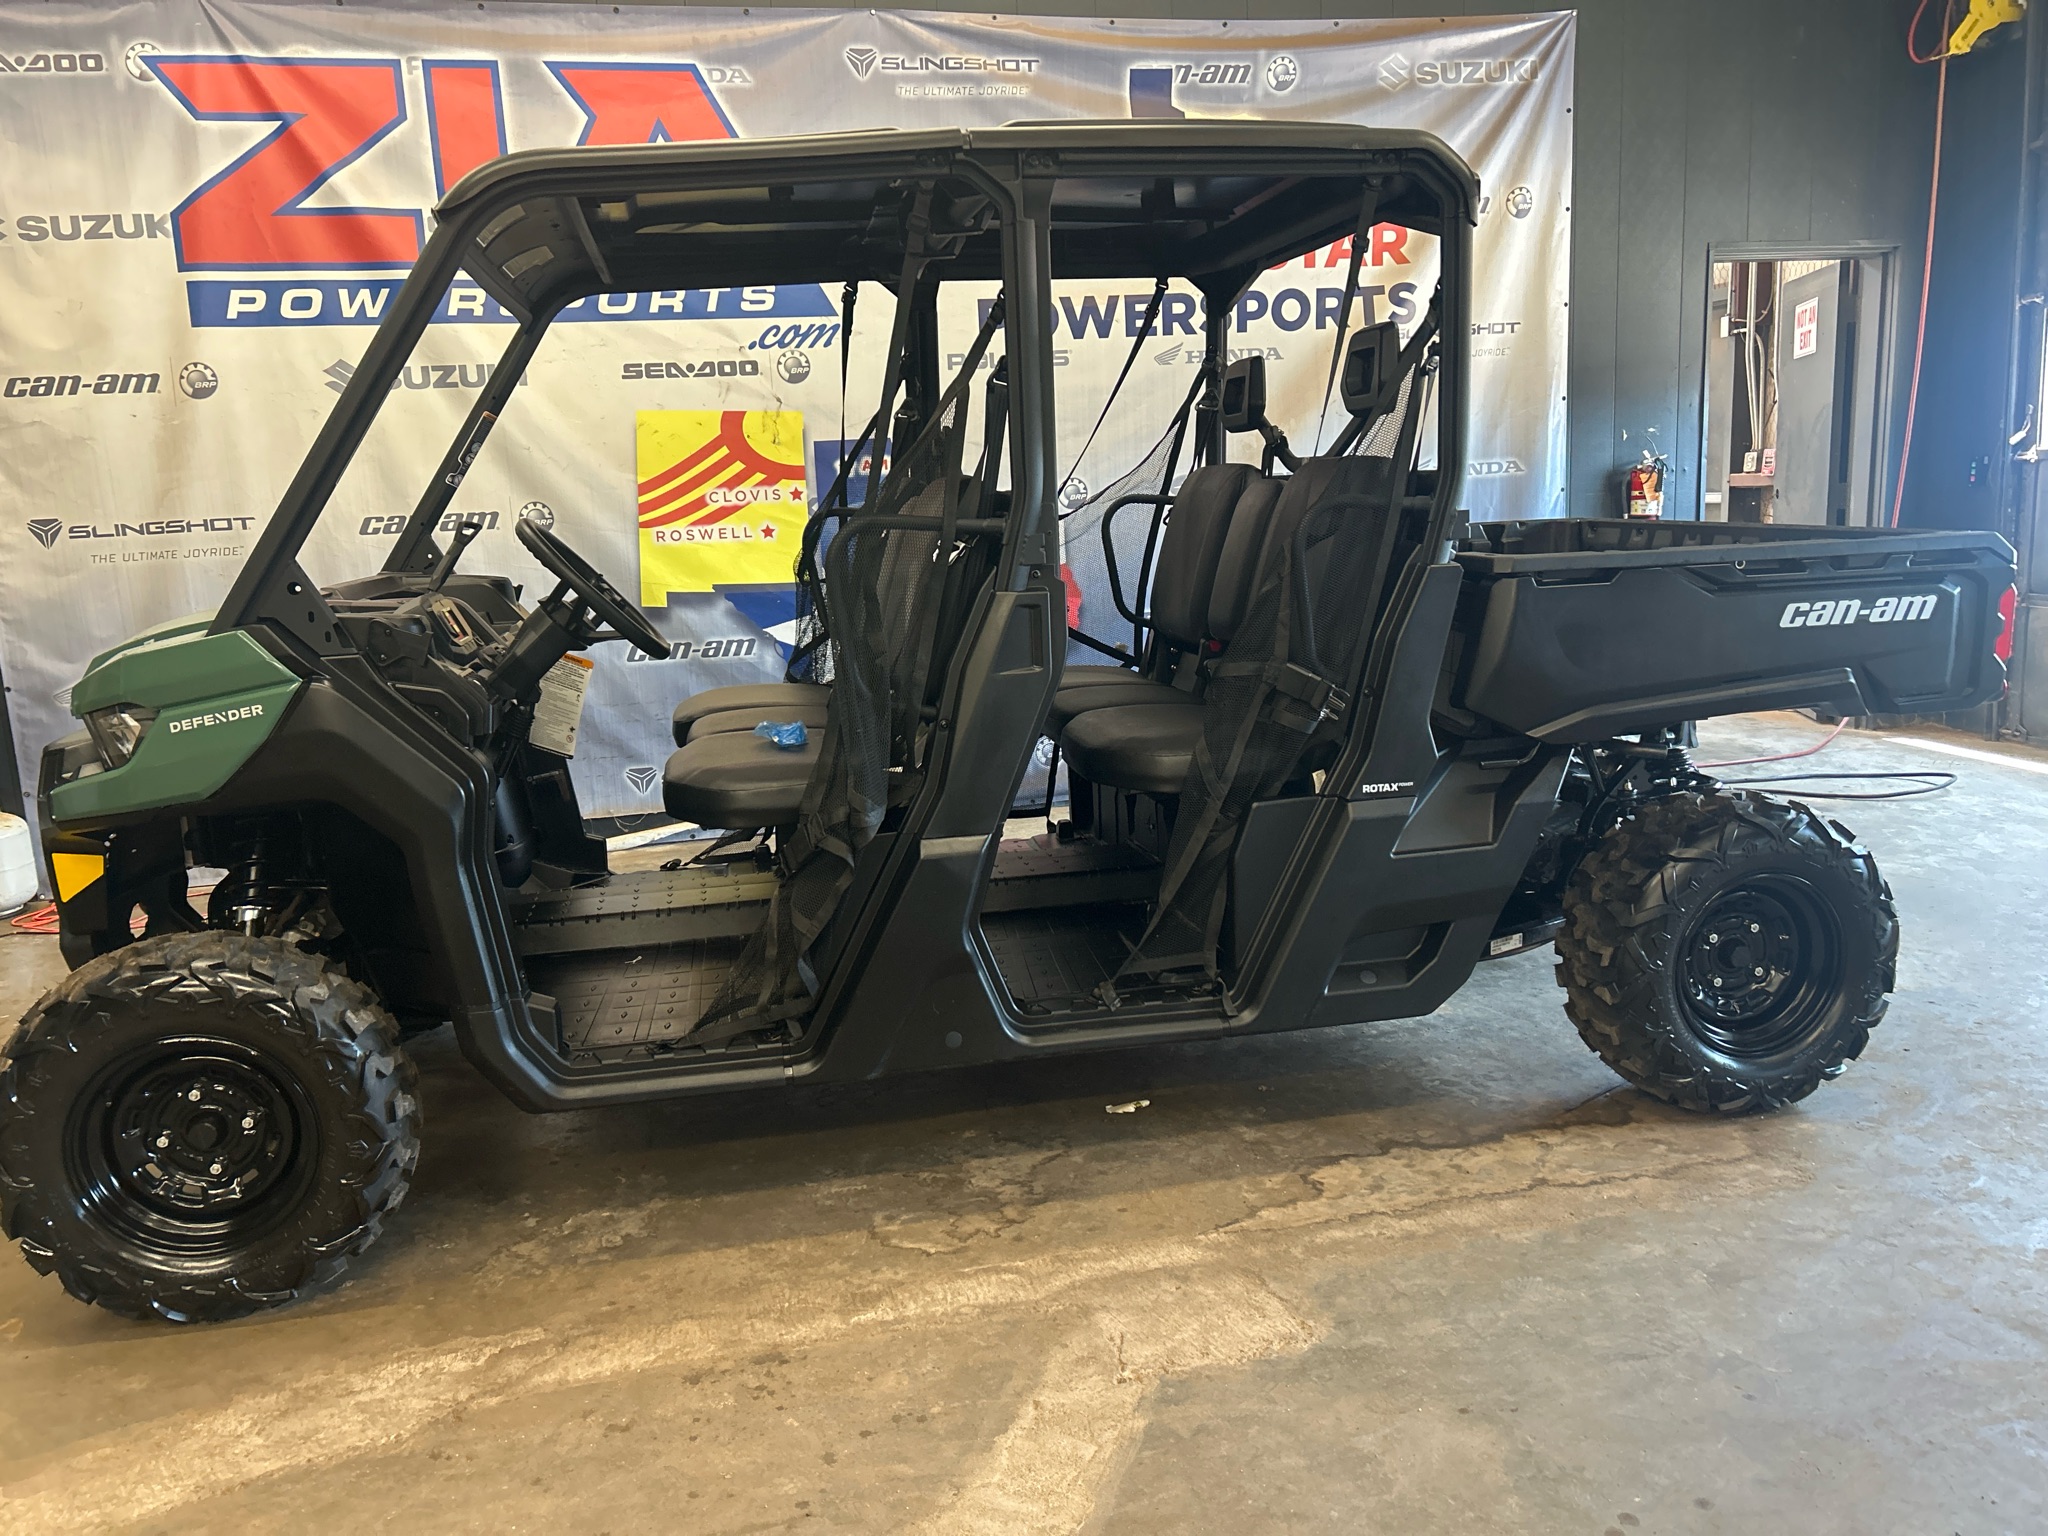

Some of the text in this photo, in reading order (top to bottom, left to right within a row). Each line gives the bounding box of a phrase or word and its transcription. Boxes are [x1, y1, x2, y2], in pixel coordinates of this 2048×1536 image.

[881, 57, 1040, 73] SLINGSHOT
[1416, 59, 1539, 84] SUZUKI
[1174, 64, 1251, 84] n-am
[899, 86, 918, 95] THE
[923, 86, 974, 96] ULTIMATE
[16, 213, 172, 242] SUZUK
[1800, 330, 1811, 350] EXIT
[1185, 347, 1284, 364] HNDA
[790, 366, 810, 374] BRP
[3, 373, 161, 398] can-am
[194, 381, 217, 389] BRP
[1468, 460, 1525, 475] NDA
[709, 488, 781, 503] CLOVIS
[68, 516, 256, 540] SLINGSHOT
[656, 526, 753, 542] ROSWELL
[91, 553, 117, 564] THE
[122, 550, 178, 562] ULTIMATE
[1779, 594, 1938, 628] can-am
[169, 704, 264, 734] DEFENDER
[1362, 782, 1399, 793] ROTAX
